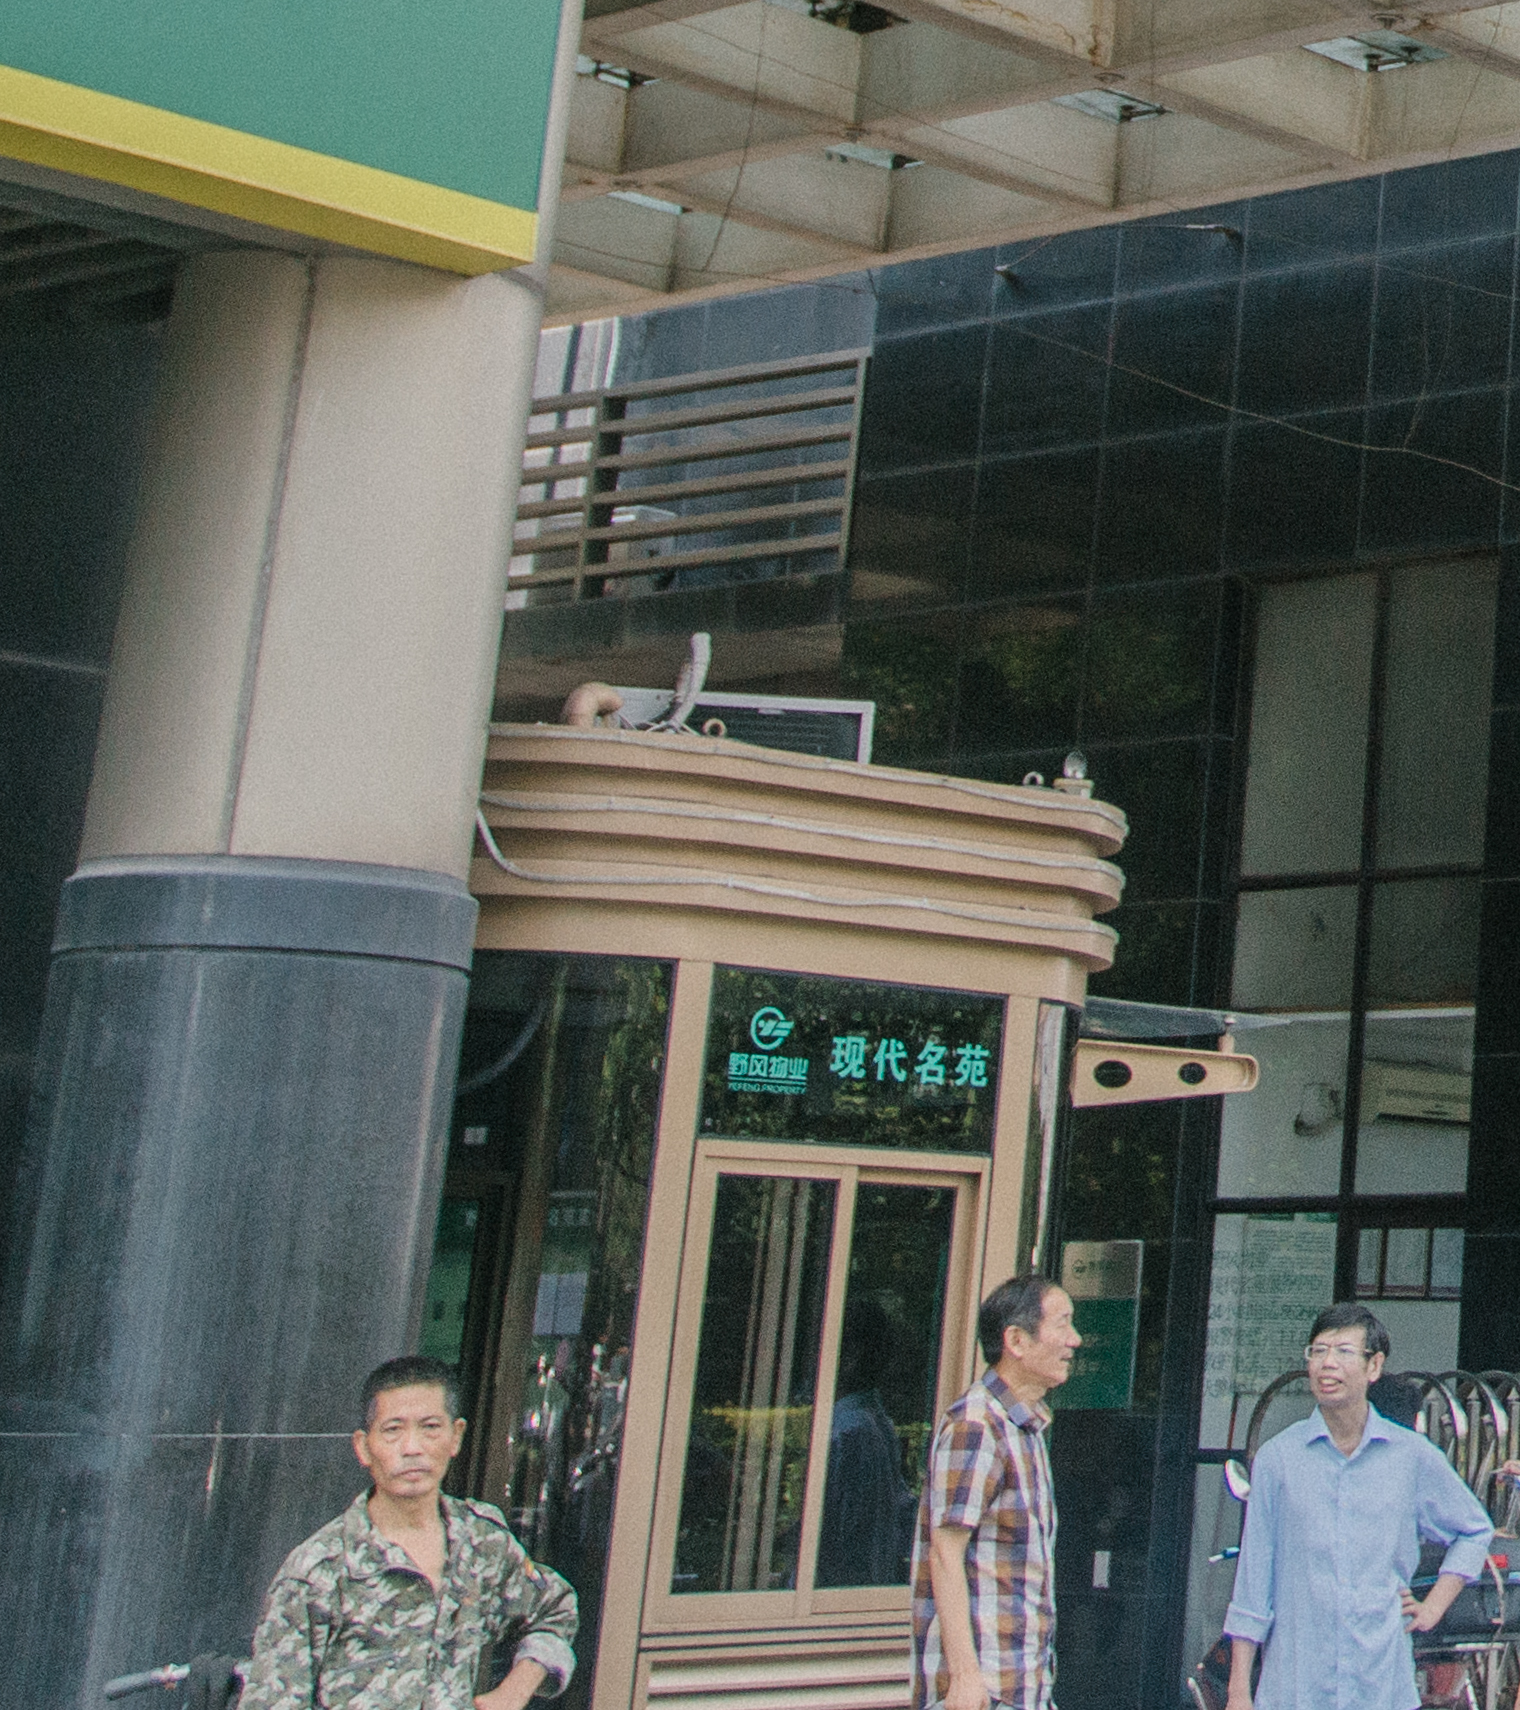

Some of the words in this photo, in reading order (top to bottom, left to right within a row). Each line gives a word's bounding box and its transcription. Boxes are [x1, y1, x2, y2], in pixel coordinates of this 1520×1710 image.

[728, 1052, 809, 1080] 野风物业
[829, 1036, 990, 1087] 现代名苑
